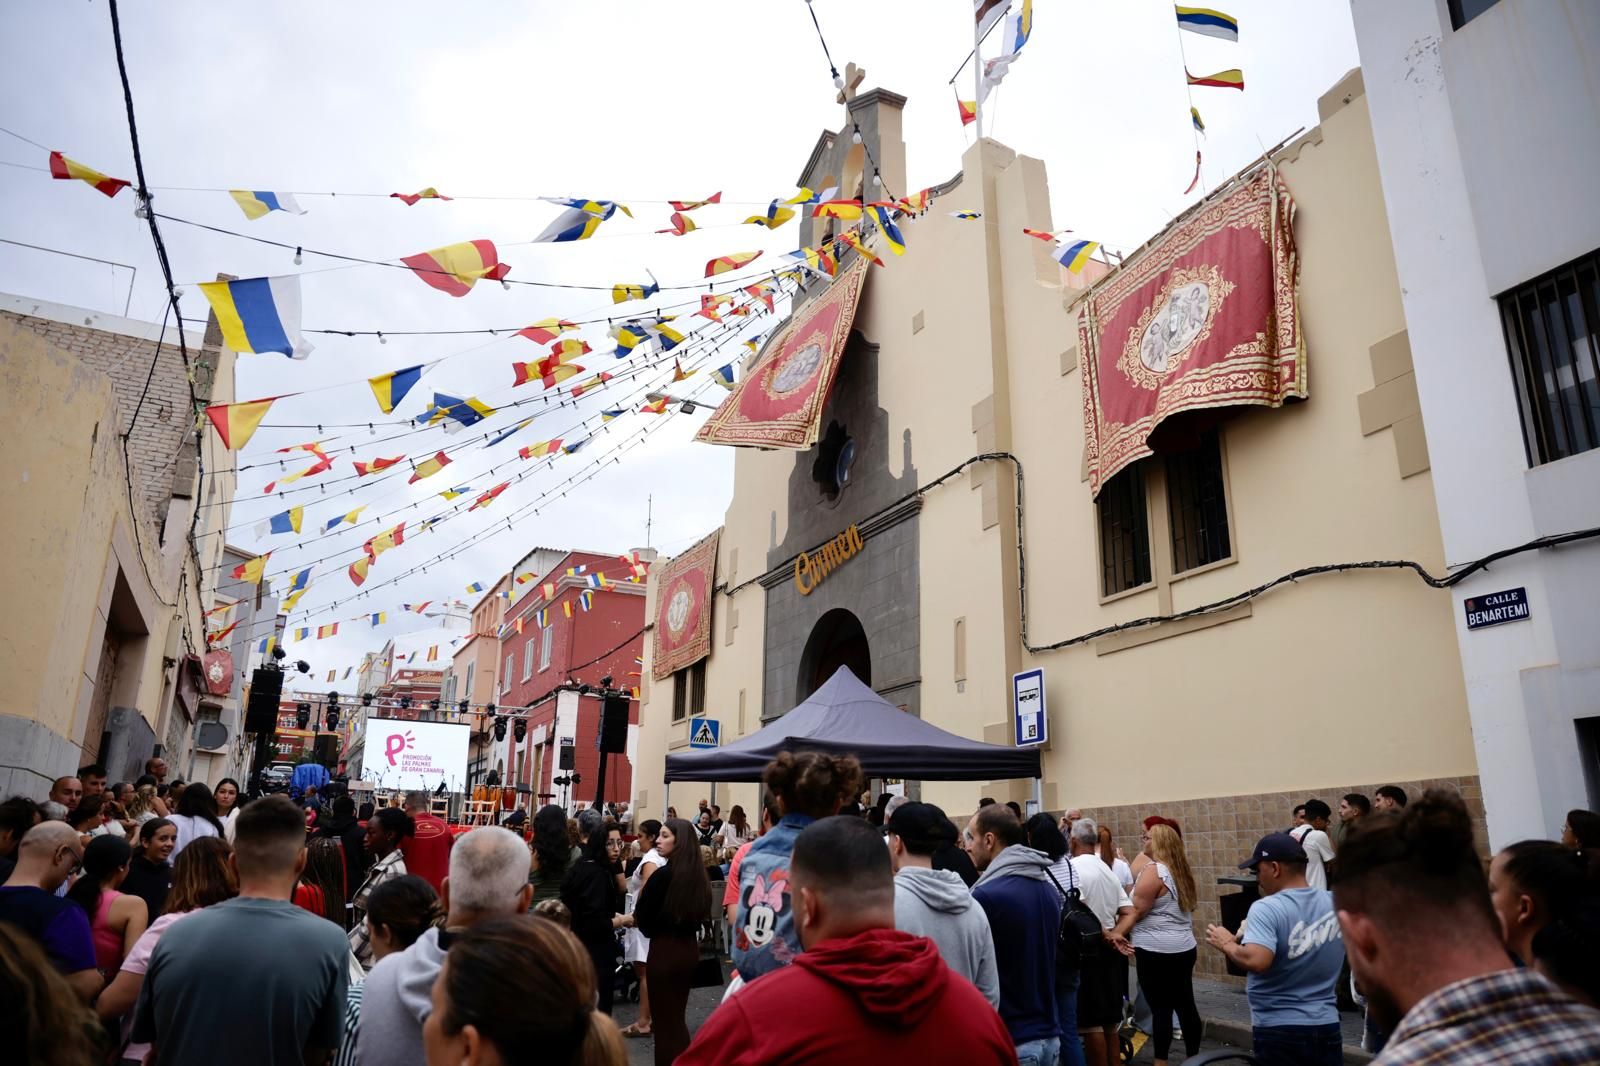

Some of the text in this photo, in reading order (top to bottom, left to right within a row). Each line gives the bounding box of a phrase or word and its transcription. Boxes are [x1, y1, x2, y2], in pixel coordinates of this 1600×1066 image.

[794, 522, 864, 596] Carmen
[1485, 592, 1519, 606] CALLE
[1468, 602, 1528, 626] BENARTEMI
